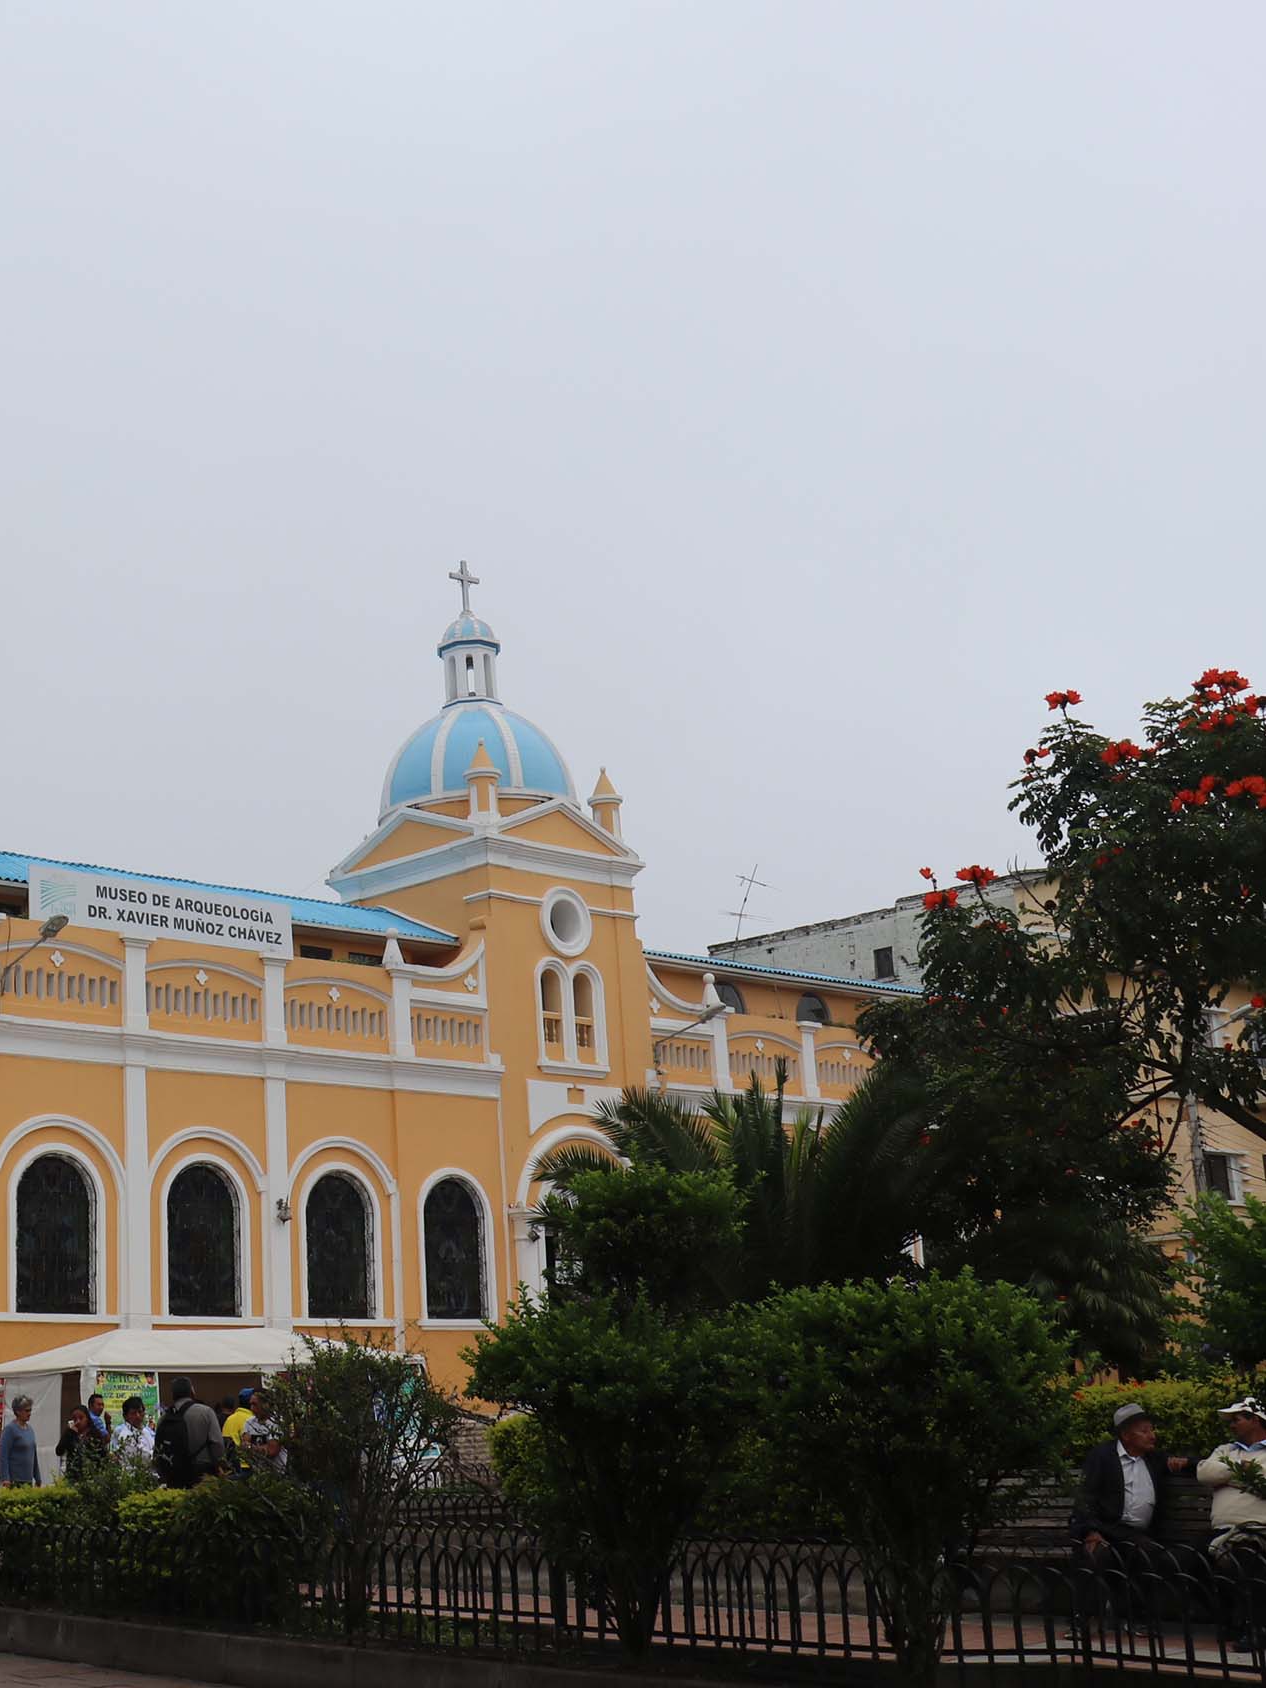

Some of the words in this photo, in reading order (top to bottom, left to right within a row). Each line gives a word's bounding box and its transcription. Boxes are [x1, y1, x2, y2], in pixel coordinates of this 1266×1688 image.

[88, 904, 112, 921] DR.
[116, 908, 170, 928] XAVIER
[174, 914, 224, 937] MUÑOZ
[228, 925, 283, 946] CHÁVEZ
[96, 885, 148, 905] MUSEO
[152, 893, 171, 909] DE
[174, 897, 274, 925] ARQUEOLOGÍA
